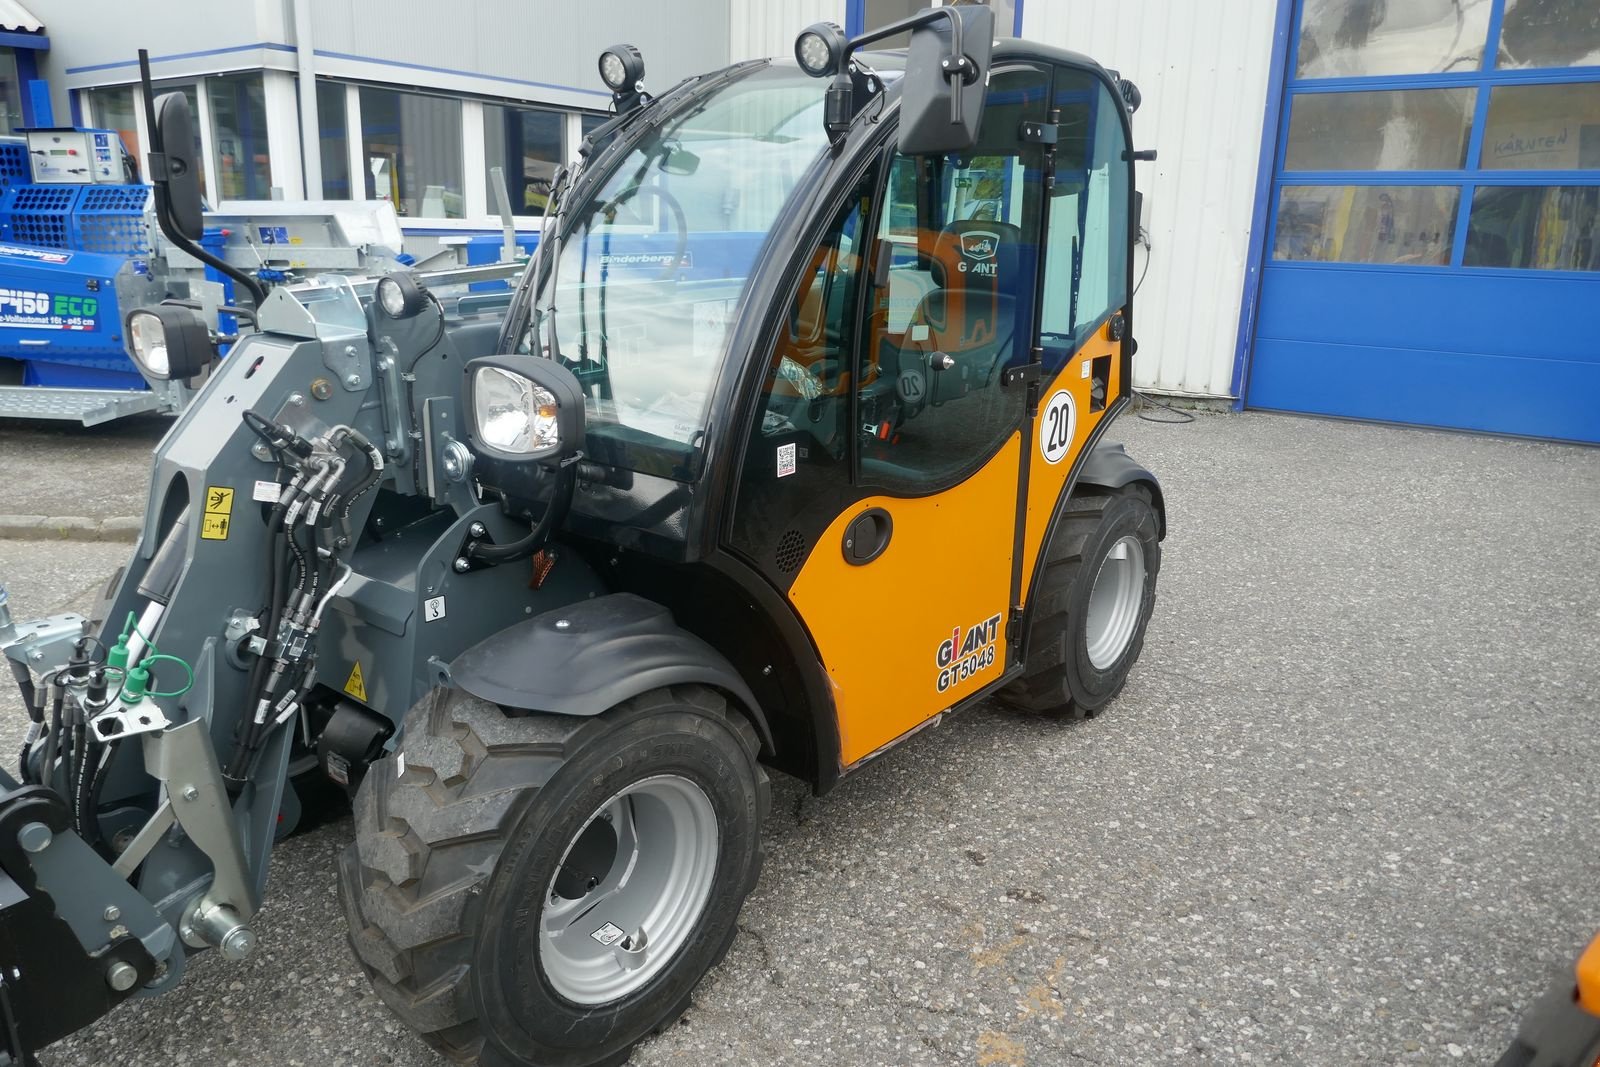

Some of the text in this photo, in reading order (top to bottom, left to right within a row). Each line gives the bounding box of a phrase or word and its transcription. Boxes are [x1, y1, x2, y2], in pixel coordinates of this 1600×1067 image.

[54, 295, 97, 317] ECO
[1047, 403, 1070, 452] 20
[937, 644, 995, 693] GT5048
